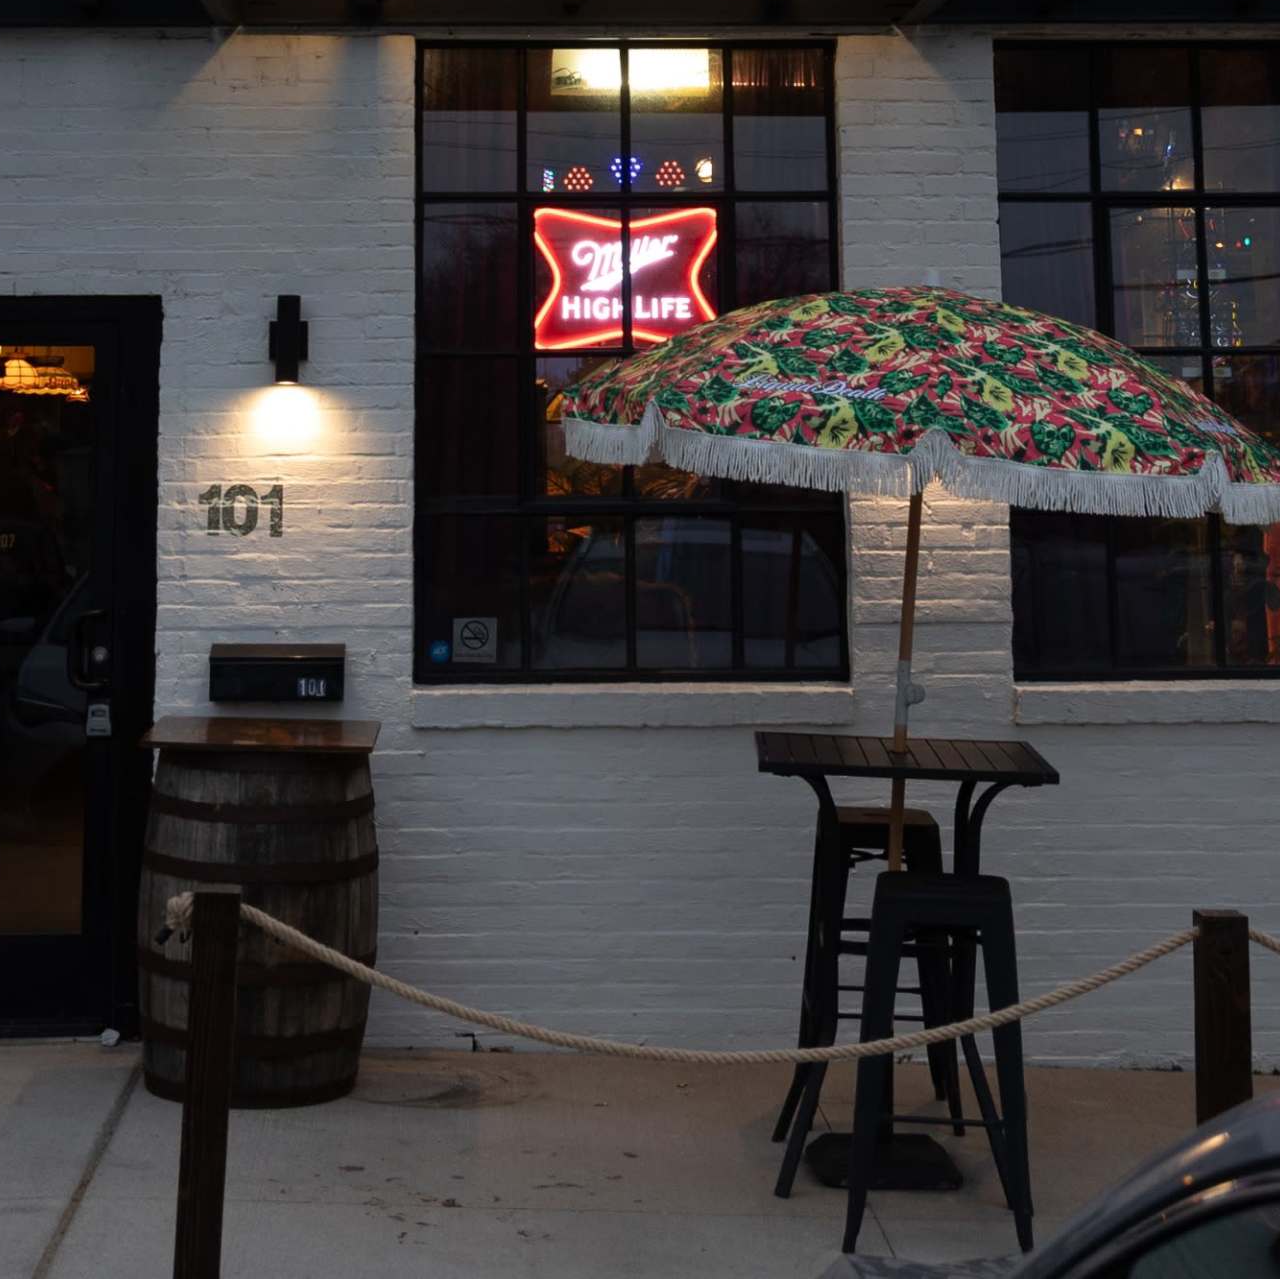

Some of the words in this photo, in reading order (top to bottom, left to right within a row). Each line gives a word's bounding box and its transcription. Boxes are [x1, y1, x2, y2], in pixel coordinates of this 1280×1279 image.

[571, 234, 679, 291] Mller
[561, 295, 624, 320] HIGH
[634, 295, 692, 320] LIFE
[735, 374, 816, 395] Liquid
[816, 380, 889, 401] Death
[198, 484, 283, 538] 101
